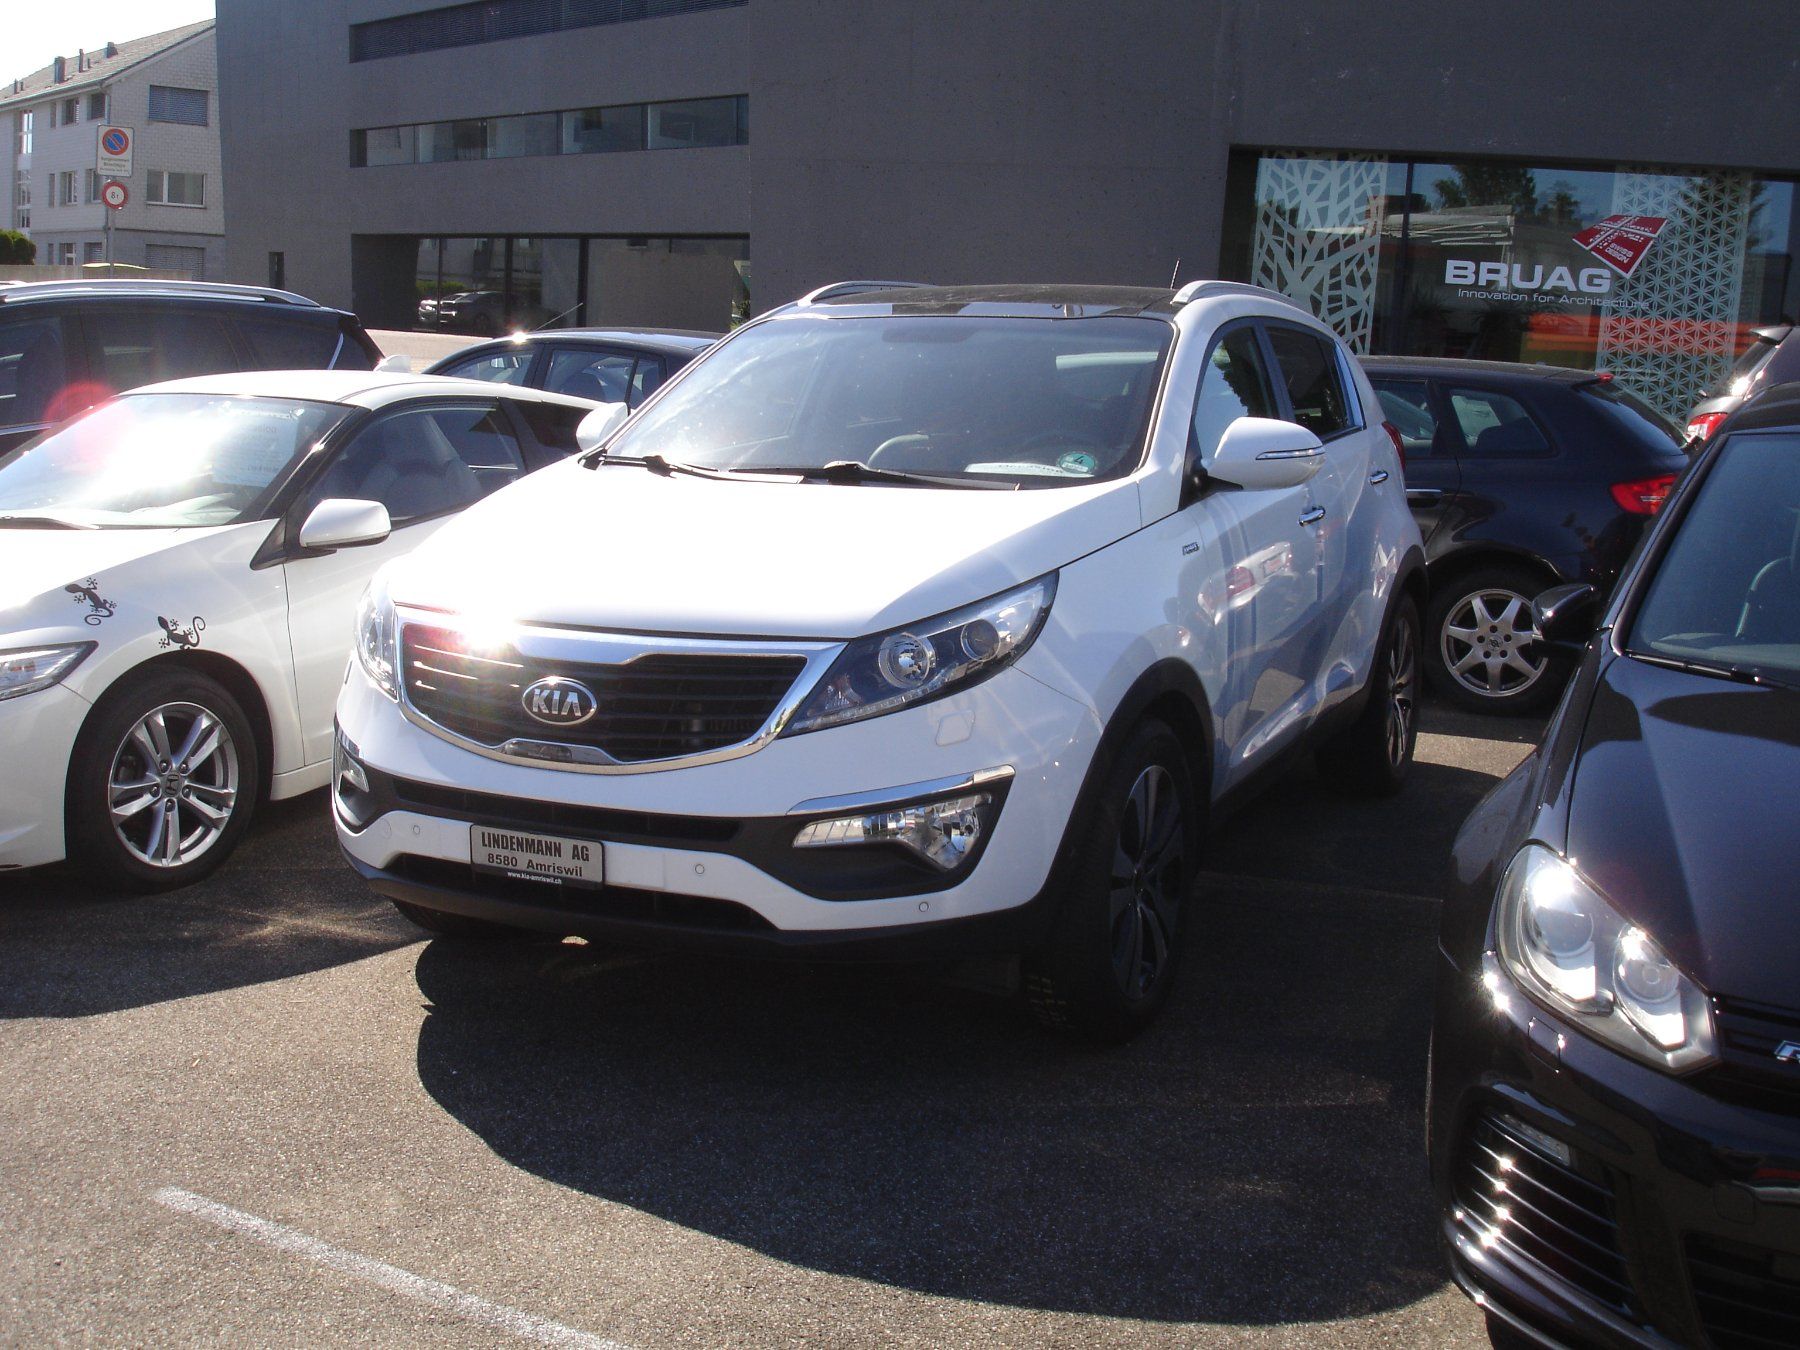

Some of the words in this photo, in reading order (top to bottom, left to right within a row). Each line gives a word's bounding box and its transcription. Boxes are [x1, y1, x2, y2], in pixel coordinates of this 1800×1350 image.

[1444, 259, 1612, 294] BRUAG
[1458, 288, 1528, 301] Innovation
[1533, 292, 1555, 304] for
[1559, 295, 1650, 309] Architecture
[532, 688, 582, 717] KIA
[481, 831, 562, 858] LINDENMANN
[571, 844, 590, 862] AG
[487, 853, 518, 868] 8580
[526, 858, 583, 878] Amriswil
